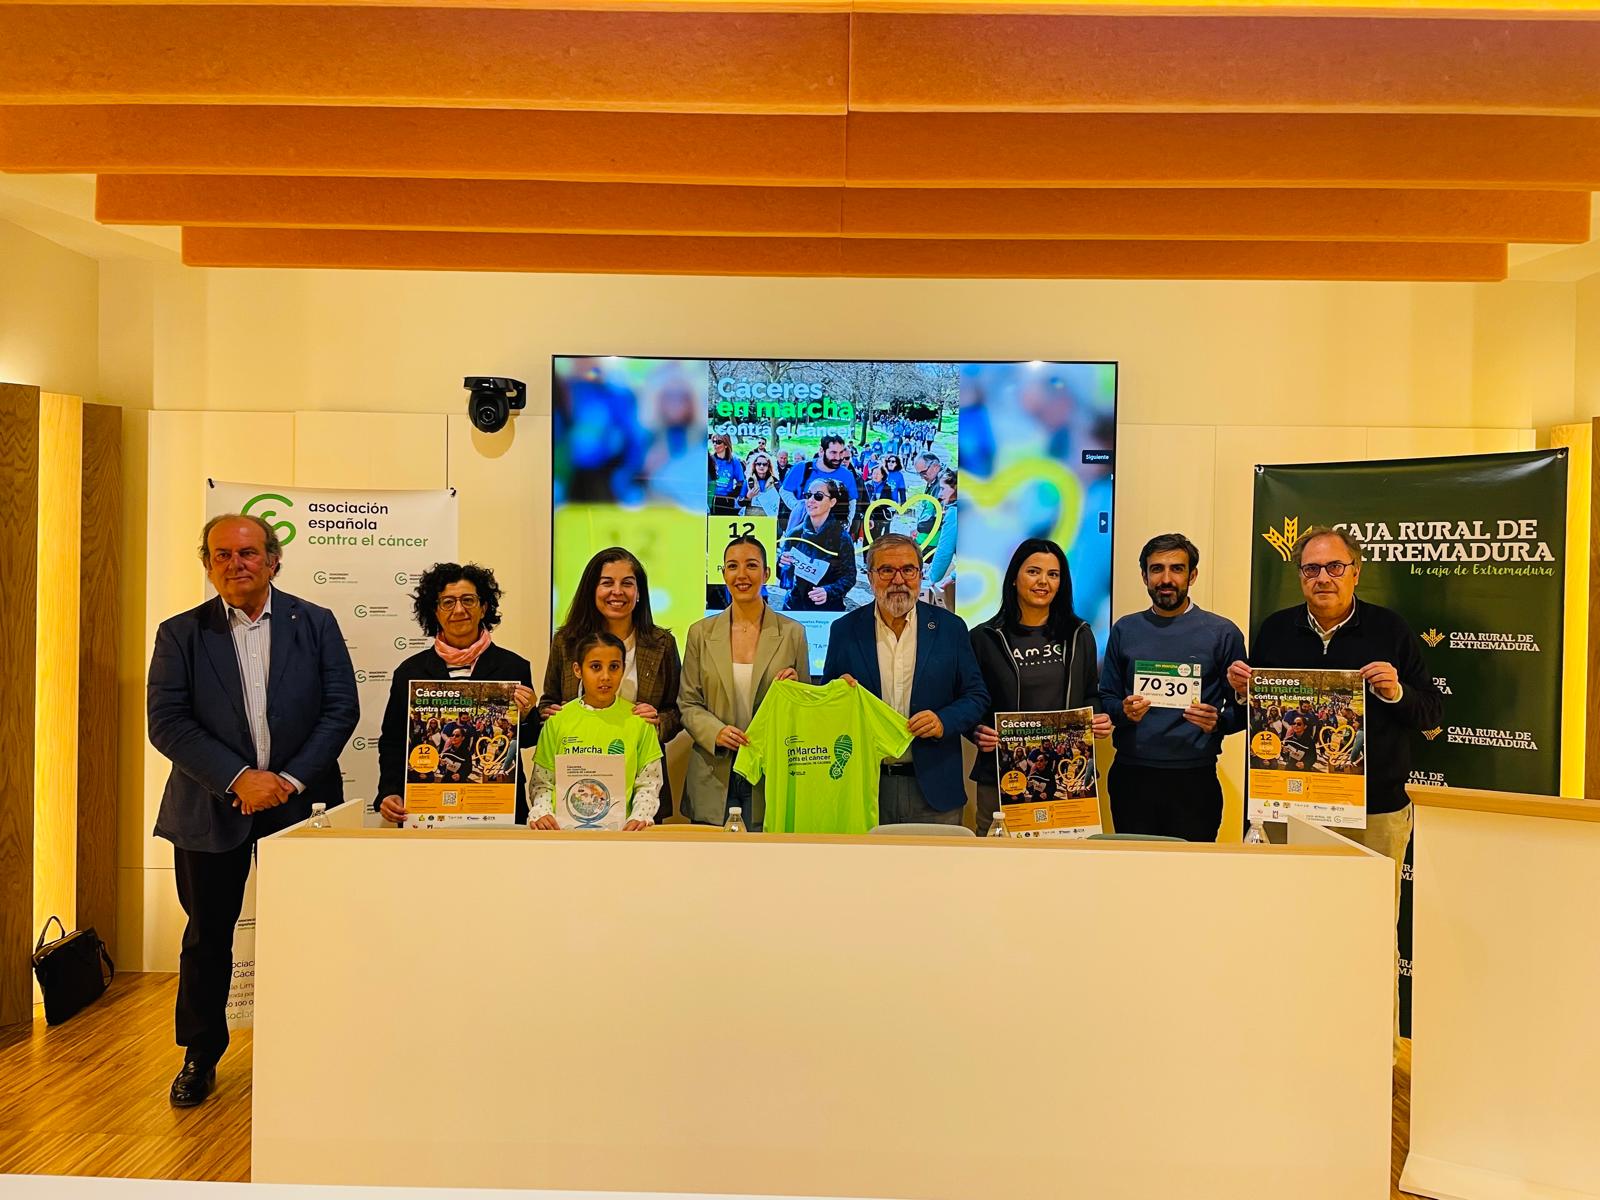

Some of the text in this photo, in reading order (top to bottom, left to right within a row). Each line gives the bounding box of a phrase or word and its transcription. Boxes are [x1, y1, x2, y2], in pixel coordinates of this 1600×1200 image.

[717, 377, 823, 399] Cáceres
[716, 396, 855, 419] en marcha
[714, 422, 772, 436] contra
[776, 423, 791, 436] el
[308, 501, 388, 515] asociación
[308, 517, 377, 532] española
[728, 522, 755, 538] 12
[1398, 521, 1490, 541] RURAL
[1497, 519, 1537, 539] DE
[308, 534, 429, 547] contra el cáncer
[1426, 565, 1451, 577] caja
[1454, 564, 1469, 575] de
[1472, 563, 1555, 576] Extremadura
[1450, 632, 1534, 643] CAJA RURAL DE
[1449, 640, 1540, 652] EXTREMADURA
[1254, 676, 1300, 686] Cáceres
[415, 688, 460, 698] Cáceres
[1254, 684, 1314, 694] en marcha
[415, 696, 473, 706] en marcha
[1001, 719, 1042, 728] Cáceres
[1016, 726, 1053, 735] marcha
[1447, 726, 1531, 741] CAJA RURAL DE
[1447, 734, 1538, 750] EXTREMADURA
[572, 745, 603, 754] Marcha
[1429, 771, 1444, 781] DE
